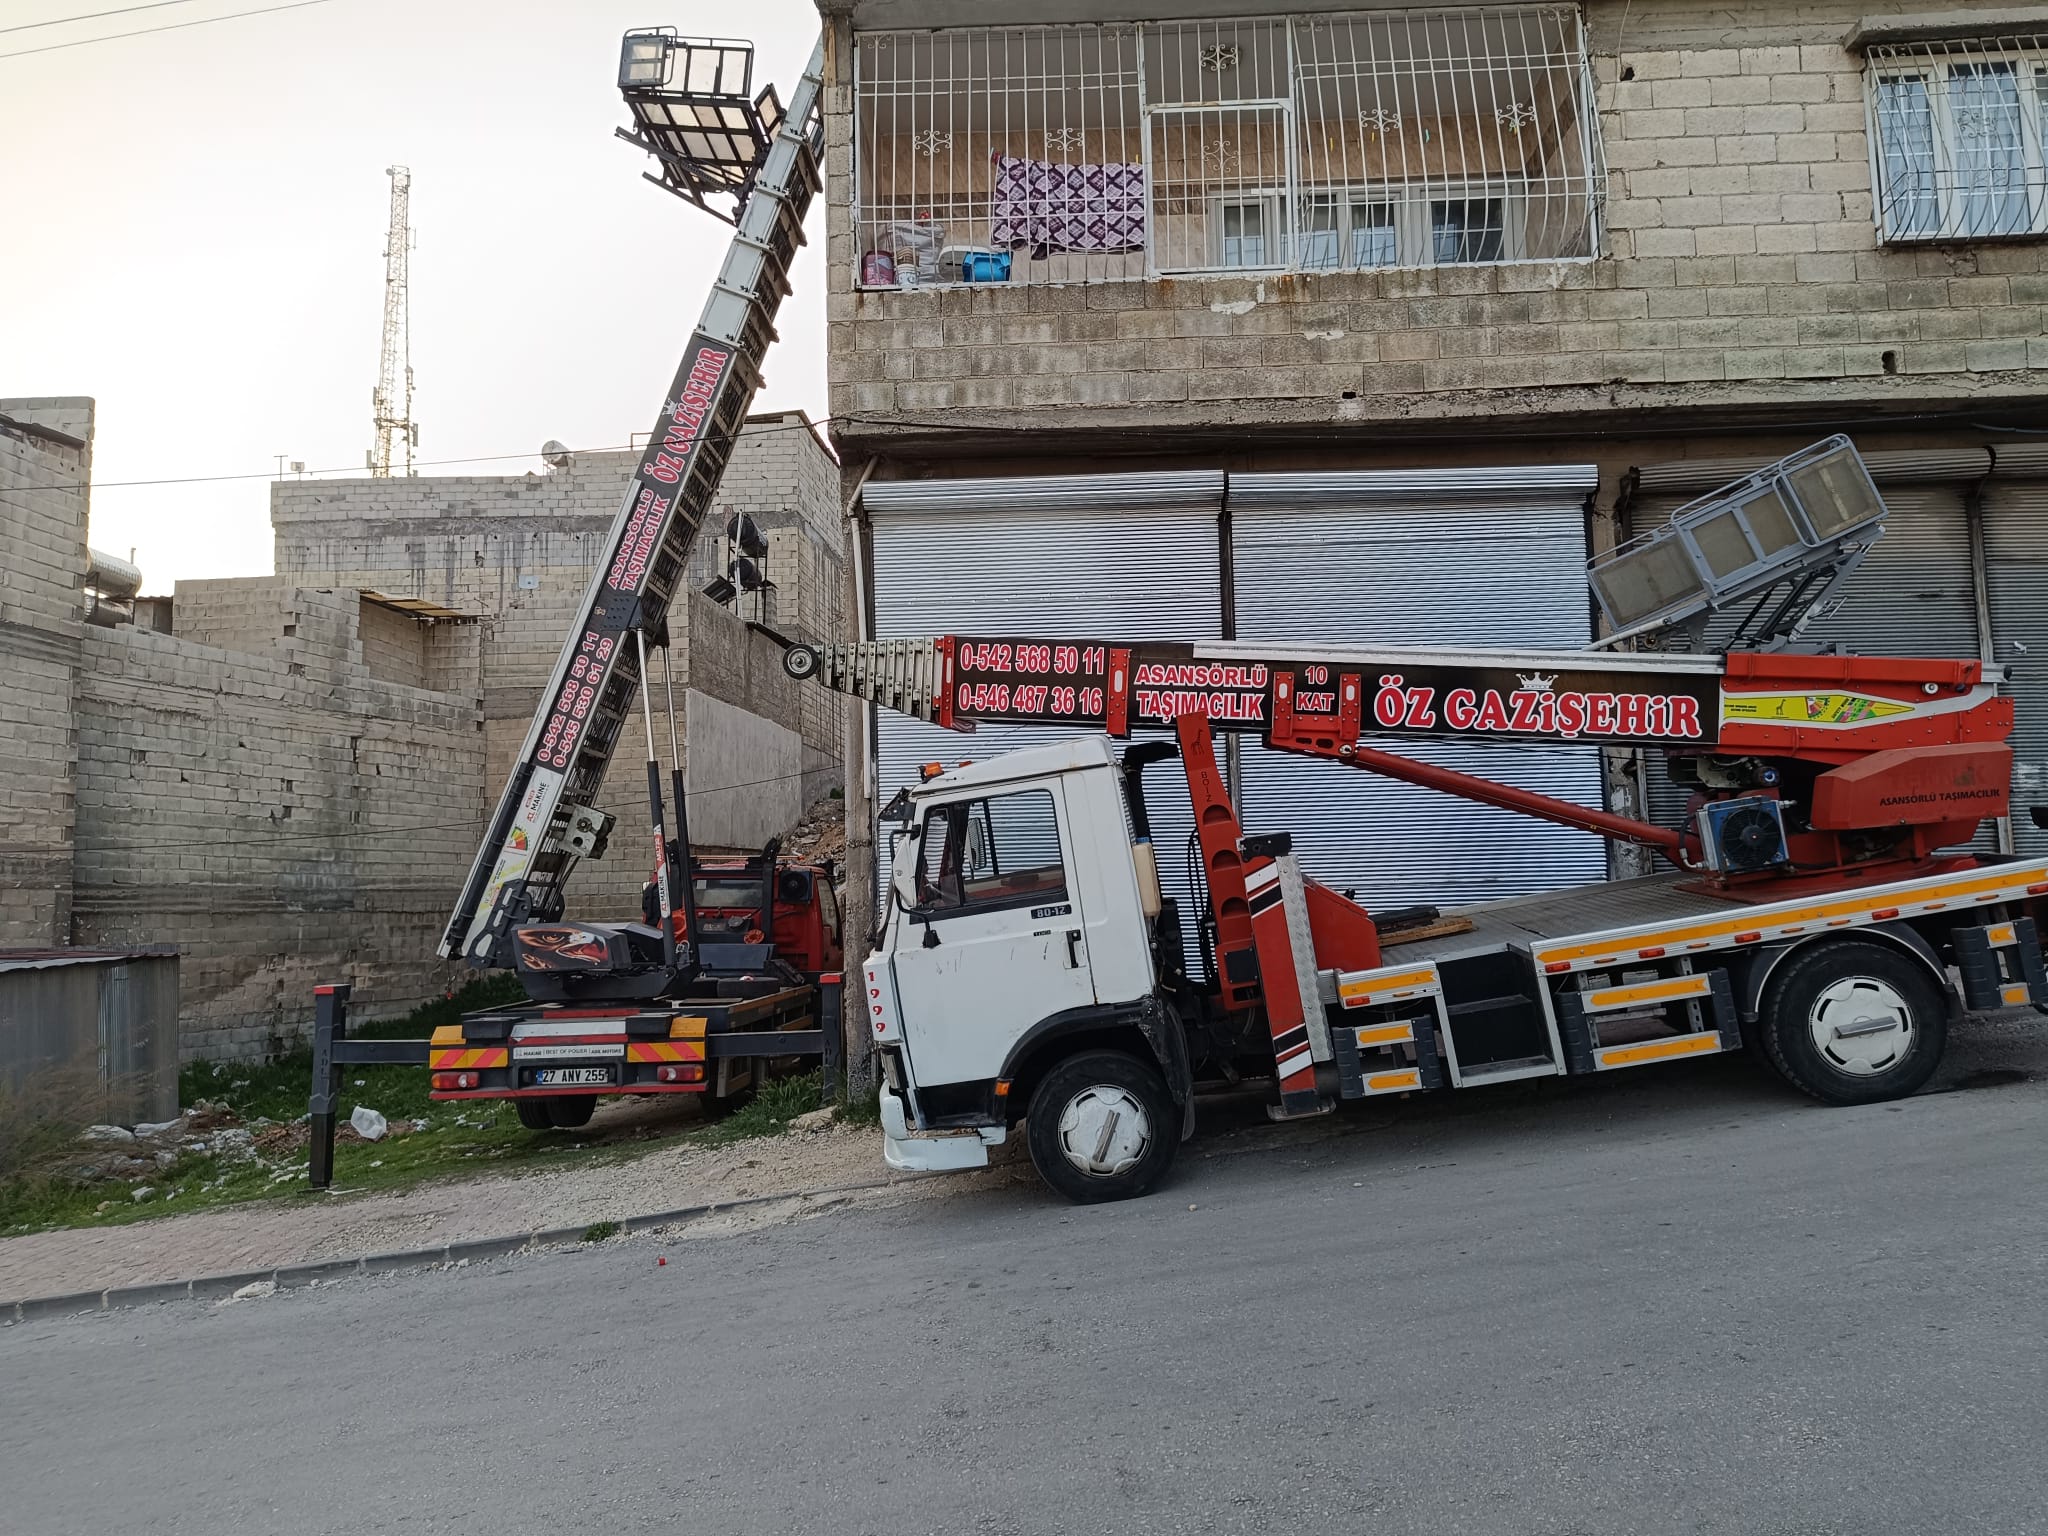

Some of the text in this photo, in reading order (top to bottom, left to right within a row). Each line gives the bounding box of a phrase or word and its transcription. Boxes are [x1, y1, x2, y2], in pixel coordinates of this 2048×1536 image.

[643, 452, 685, 483] ÖZ
[607, 488, 654, 590] ASANSÖRLÜ
[620, 494, 670, 591] TAŞIMACILIK
[960, 642, 1105, 675] 0-542 568 50 11
[1304, 665, 1328, 685] 10
[1134, 663, 1267, 688] ASANSÖRLÜ
[537, 631, 599, 761] 0-542 568 50 11
[552, 637, 613, 767] 0-545 530 61 29
[958, 683, 1103, 716] 0-546 487 36 16
[1136, 690, 1265, 723] TAŞIMACILIK
[1296, 691, 1335, 711] KAT
[1374, 674, 1436, 728] ÖZ
[543, 1071, 556, 1083] 27
[561, 1071, 581, 1082] ANV
[585, 1070, 606, 1081] 255
